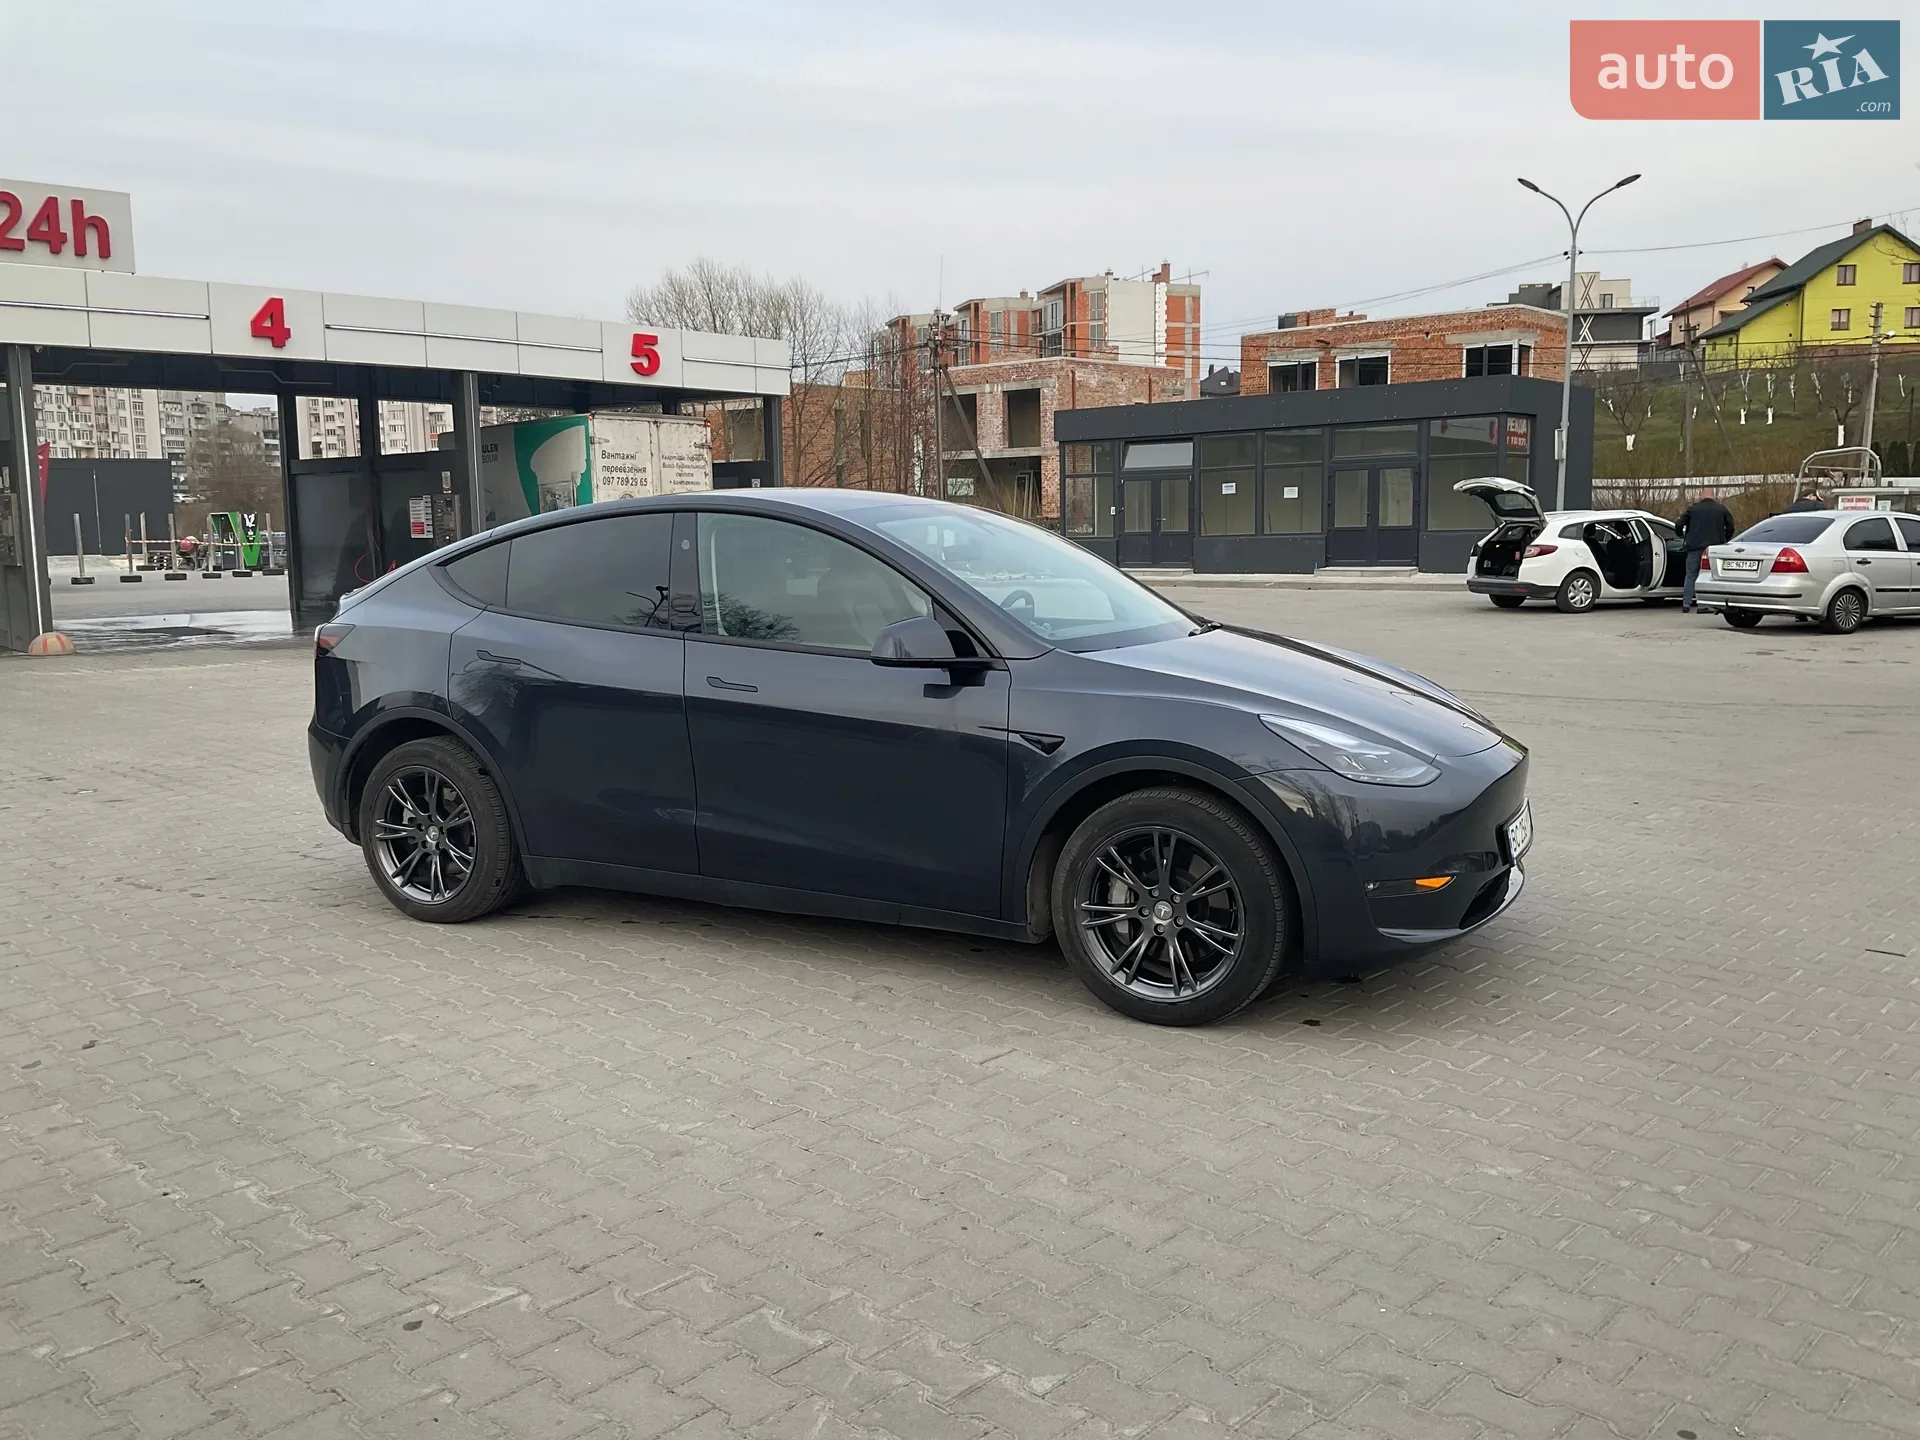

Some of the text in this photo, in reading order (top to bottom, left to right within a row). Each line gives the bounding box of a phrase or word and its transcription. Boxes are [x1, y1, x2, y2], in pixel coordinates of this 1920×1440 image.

[0, 190, 111, 259] 24h
[250, 296, 292, 348] 4
[629, 333, 661, 376] 5
[601, 449, 637, 460] Вантажні
[601, 465, 646, 475] перевезення
[602, 476, 648, 487] 097 789 29 65
